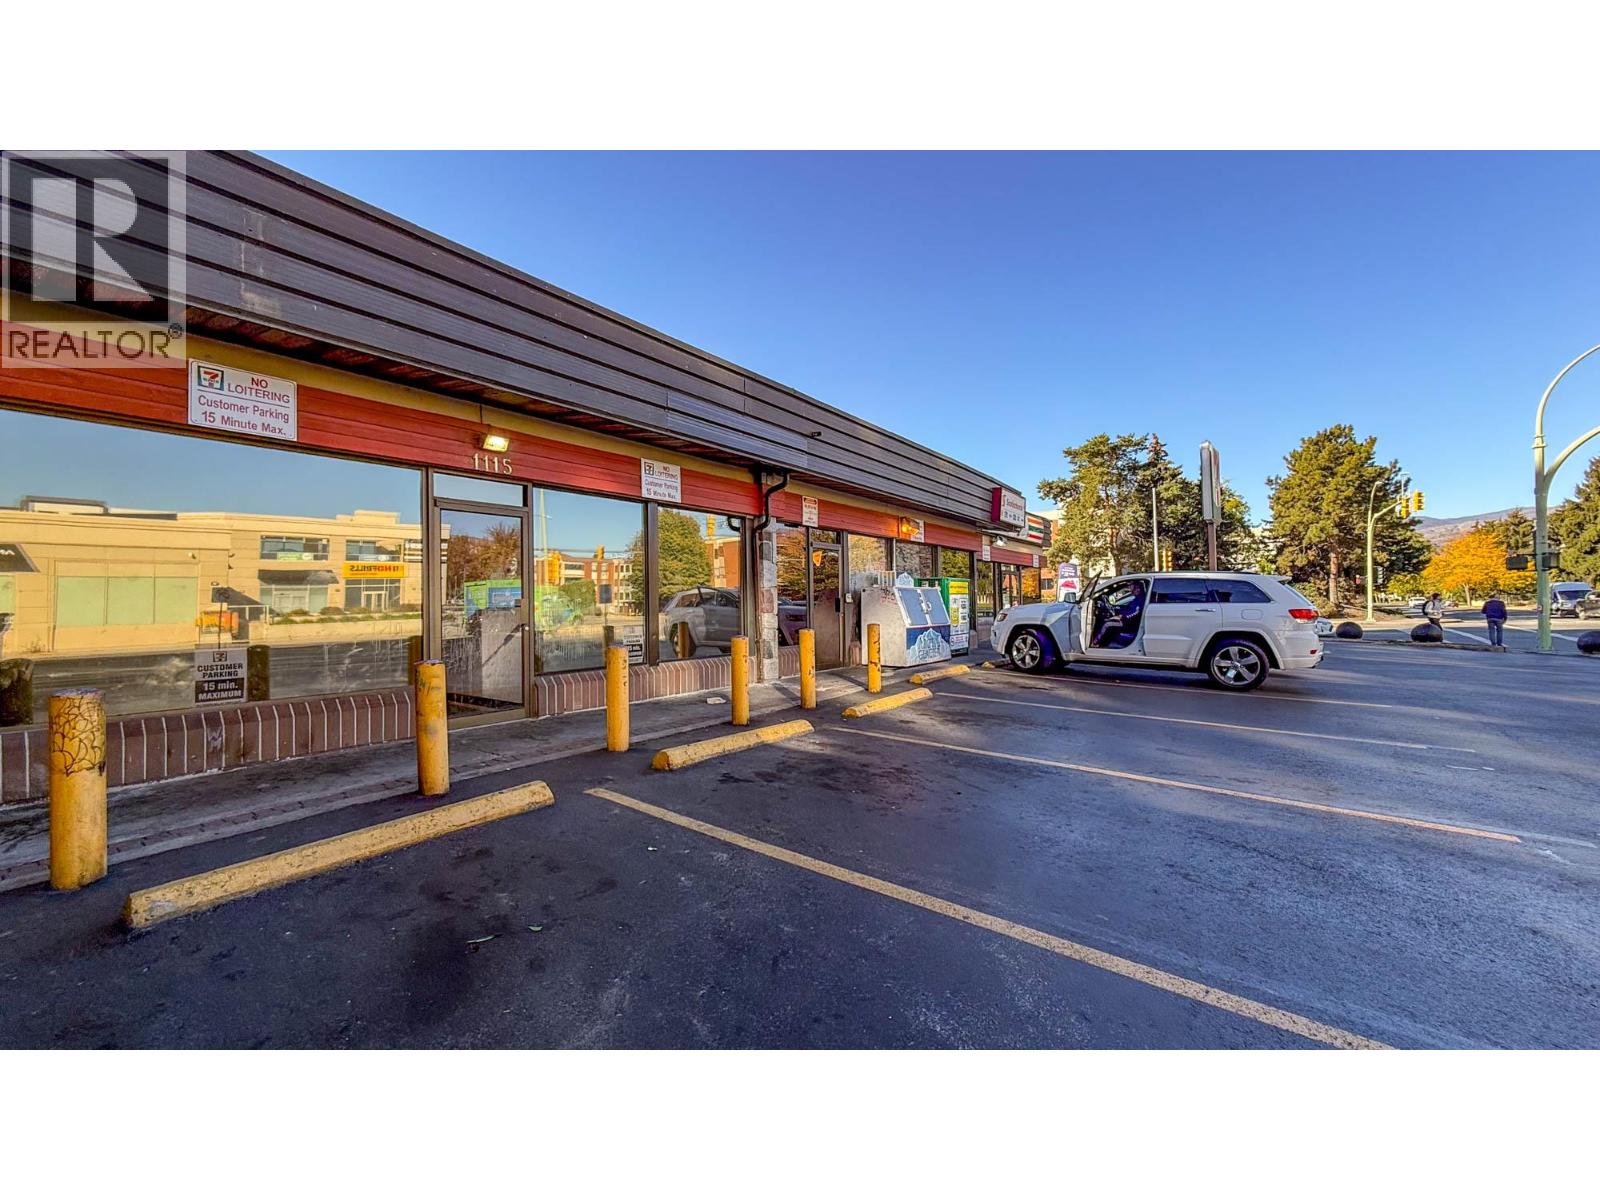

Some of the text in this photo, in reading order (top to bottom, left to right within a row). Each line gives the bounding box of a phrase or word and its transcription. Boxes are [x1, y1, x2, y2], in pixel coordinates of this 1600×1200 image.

[251, 377, 269, 389] NO
[227, 383, 290, 404] LOITERING
[198, 394, 289, 424] Customer Parking
[202, 411, 287, 436] 15 Minute Max.
[472, 453, 513, 475] 1115
[197, 663, 243, 672] CUSTOMER
[202, 670, 239, 679] PARKING
[203, 682, 216, 691] 15
[198, 690, 242, 700] MAXIMUM
